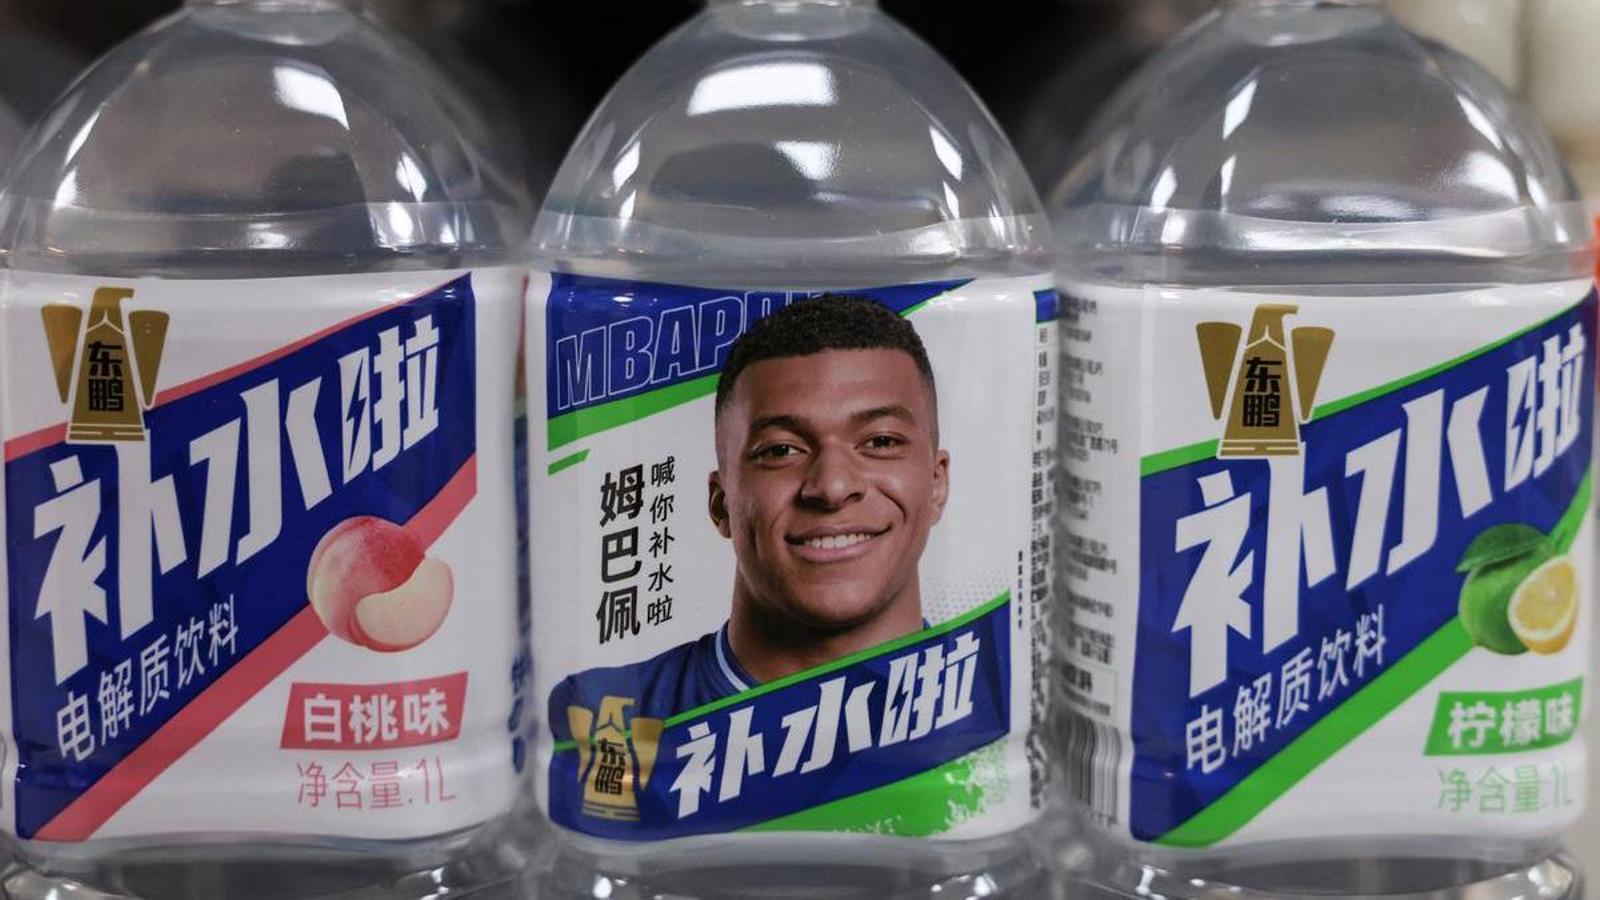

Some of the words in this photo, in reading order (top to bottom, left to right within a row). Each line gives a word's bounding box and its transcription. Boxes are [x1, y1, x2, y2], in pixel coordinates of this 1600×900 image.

[88, 341, 124, 412] 东鹏
[556, 290, 826, 411] MBAP
[1242, 356, 1283, 428] 东鹏
[33, 313, 441, 687] 补水啦
[596, 464, 645, 645] 姆巴佩
[646, 456, 675, 627] 喊你补水啦
[1172, 325, 1586, 698] 补水啦
[56, 594, 239, 762] 电解质饮料
[303, 689, 450, 745] 白桃味
[670, 635, 980, 818] 补水啦
[1184, 603, 1387, 775] 电解质饮料
[1448, 691, 1575, 748] 柠檬味
[595, 737, 627, 796] 东鹏
